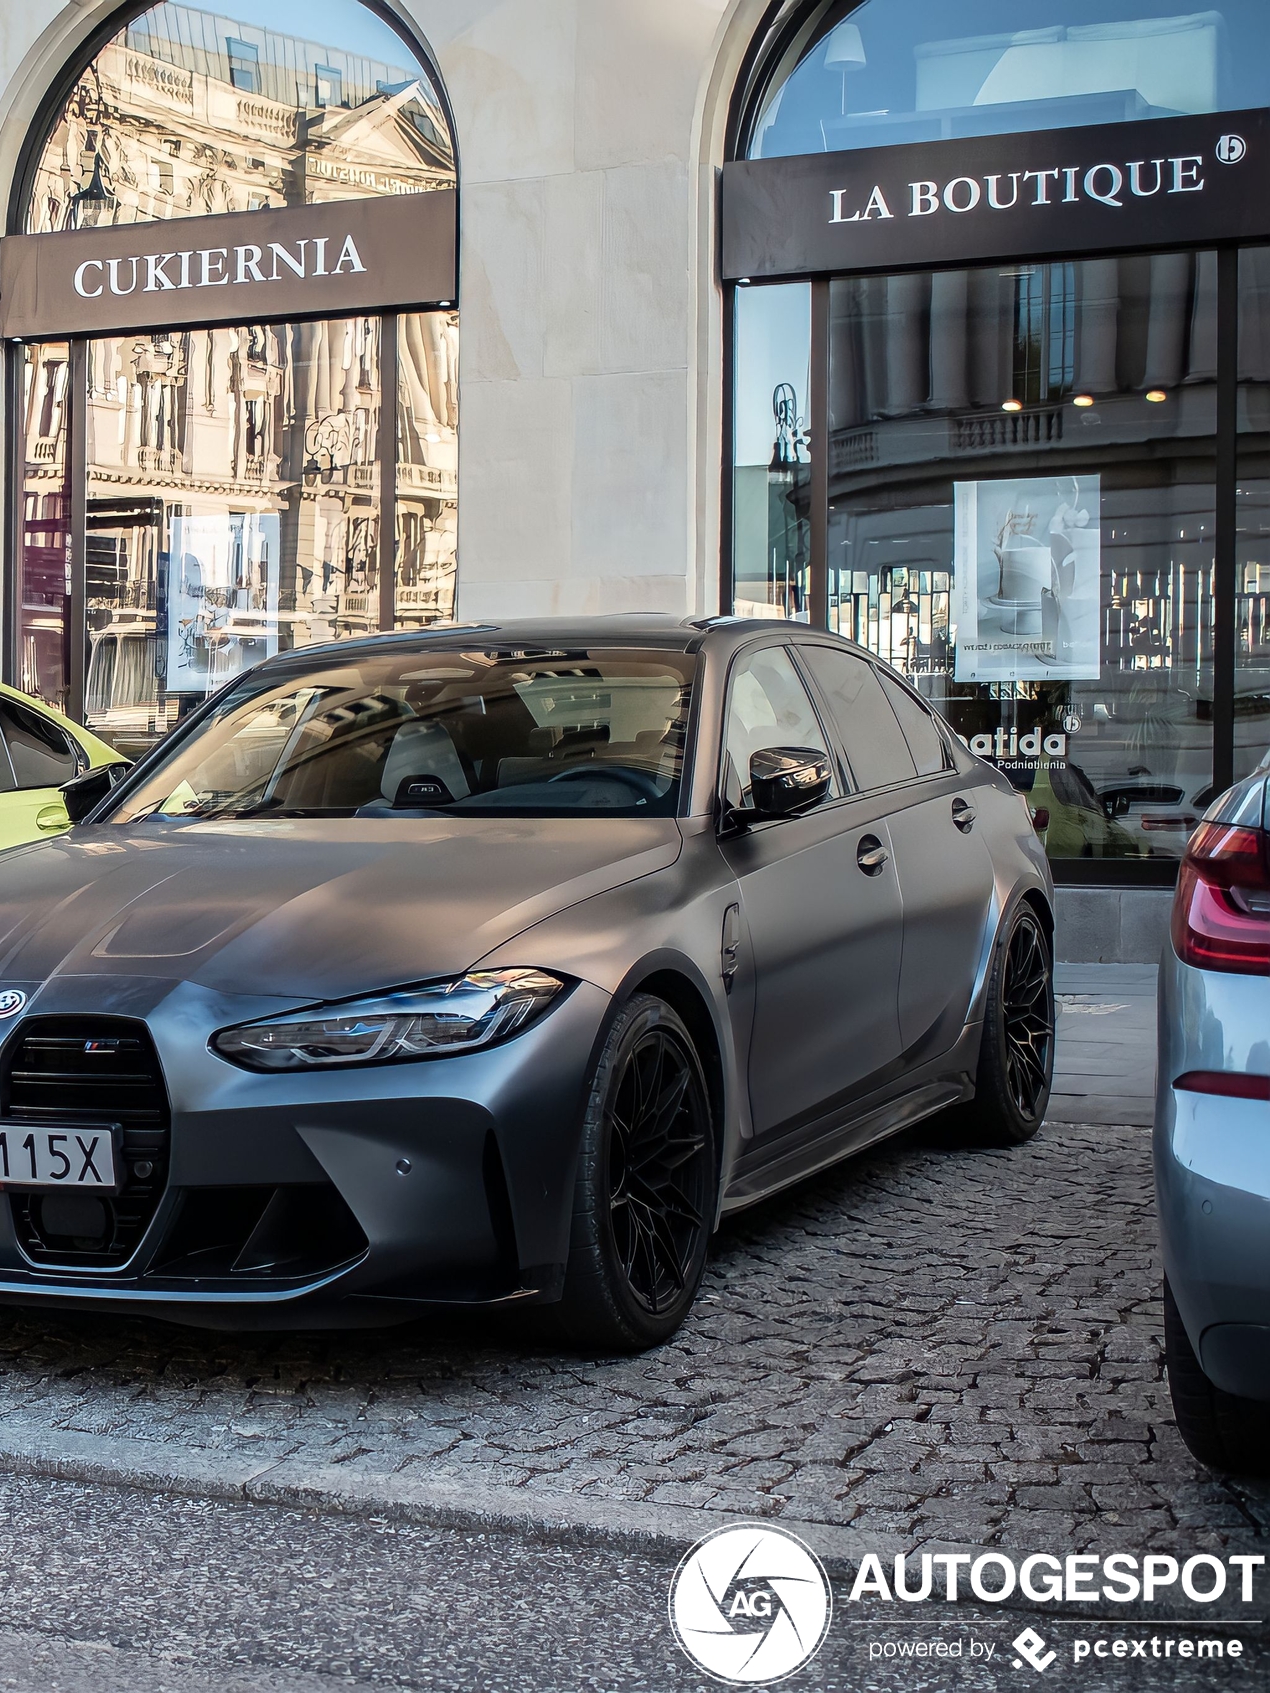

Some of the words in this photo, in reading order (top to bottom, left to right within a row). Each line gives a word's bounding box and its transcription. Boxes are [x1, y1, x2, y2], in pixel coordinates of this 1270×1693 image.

[828, 185, 894, 224] LA
[907, 156, 1205, 216] BOUTIQUE
[72, 234, 367, 298] CUKIERNIA
